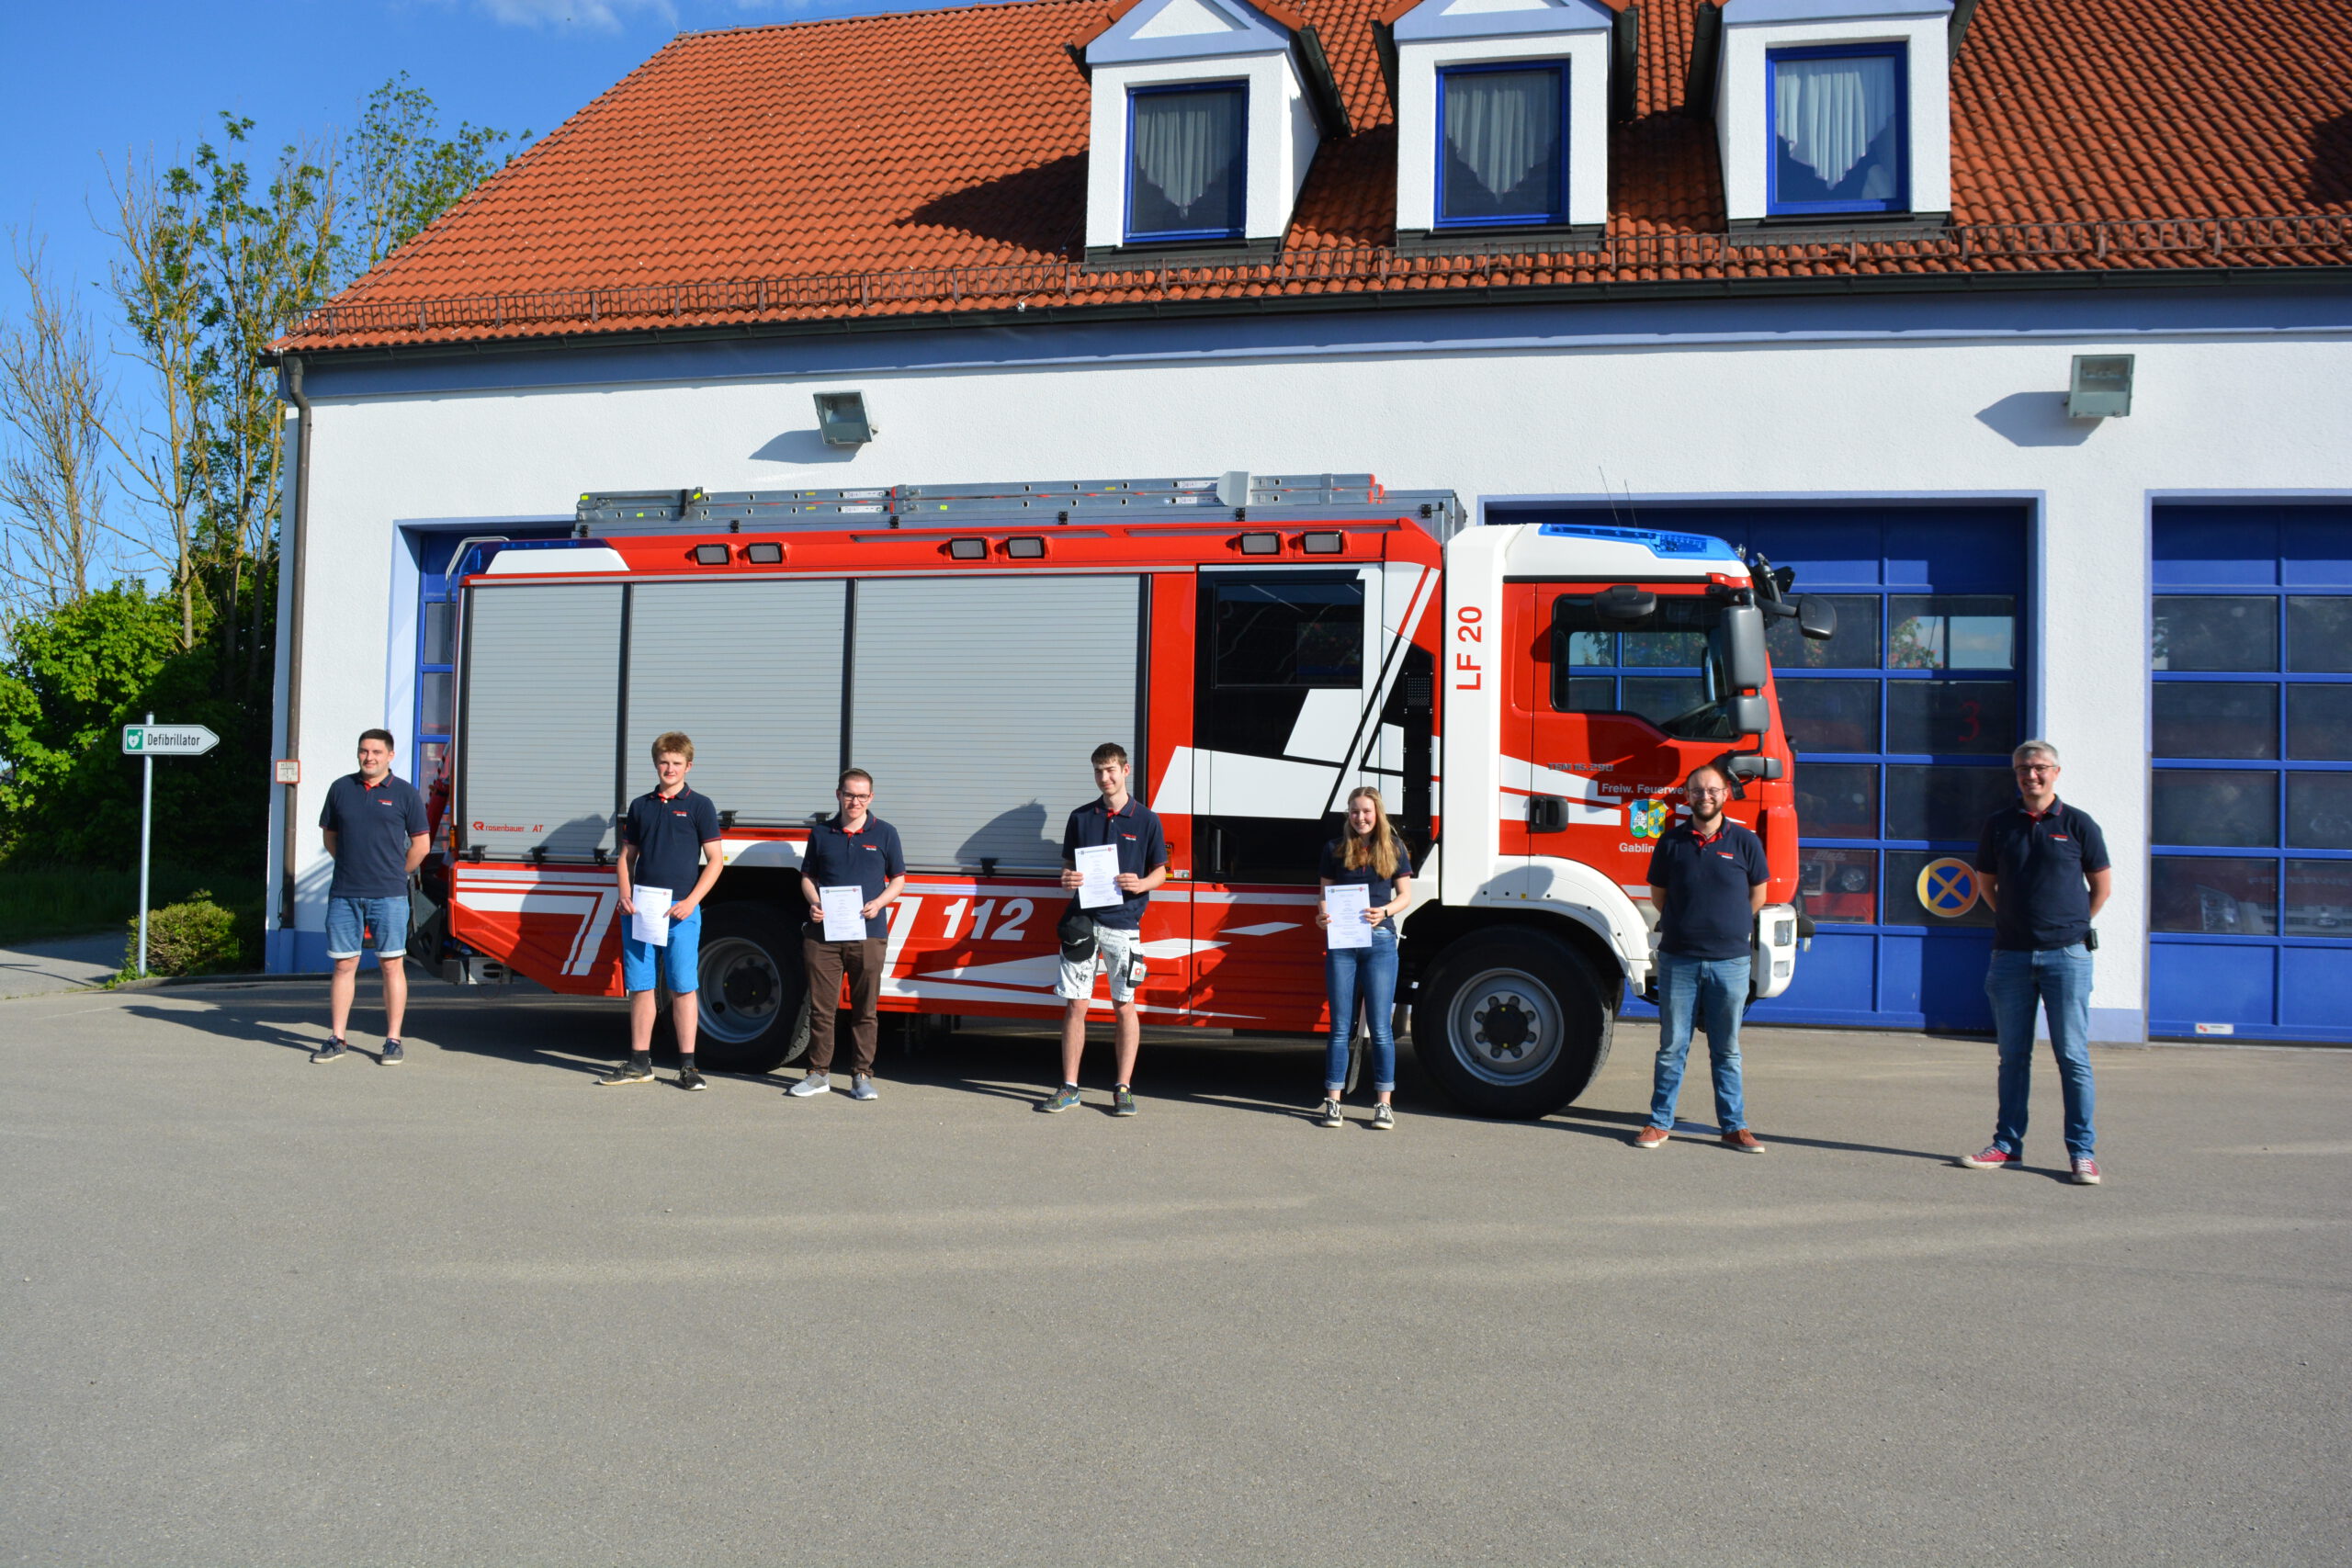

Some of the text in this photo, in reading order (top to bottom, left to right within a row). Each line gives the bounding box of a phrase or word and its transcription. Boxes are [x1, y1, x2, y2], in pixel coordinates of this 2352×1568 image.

[1456, 606, 1482, 690] LF 20
[1958, 701, 1980, 741] 3
[147, 733, 200, 746] Defibrillator
[1601, 783, 1684, 795] Freiw. Feuerwe
[532, 824, 544, 832] AT
[1619, 841, 1656, 853] Gablin
[943, 897, 1035, 942] 112
